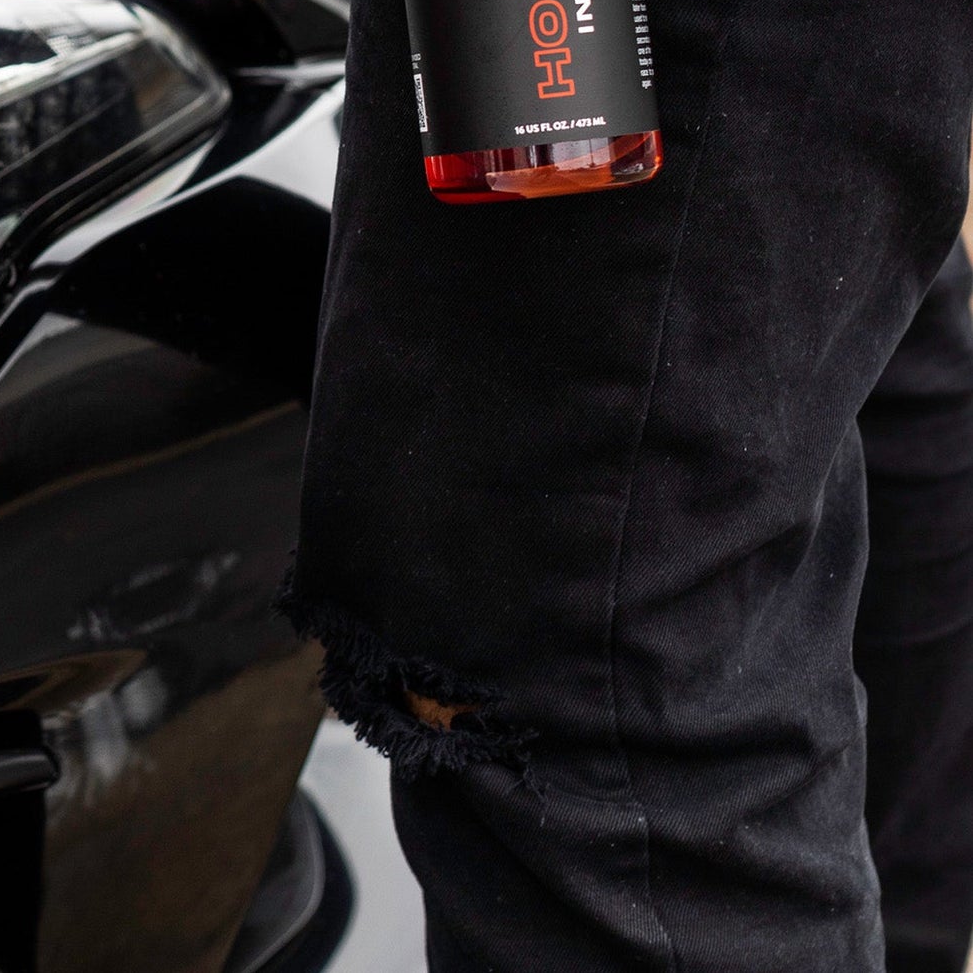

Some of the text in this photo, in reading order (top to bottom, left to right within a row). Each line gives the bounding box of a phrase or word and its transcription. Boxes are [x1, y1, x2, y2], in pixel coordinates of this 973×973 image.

[514, 125, 525, 135] 16
[526, 123, 540, 134] US
[540, 122, 553, 132] FL
[575, 117, 592, 128] 473
[592, 116, 607, 126] ML
